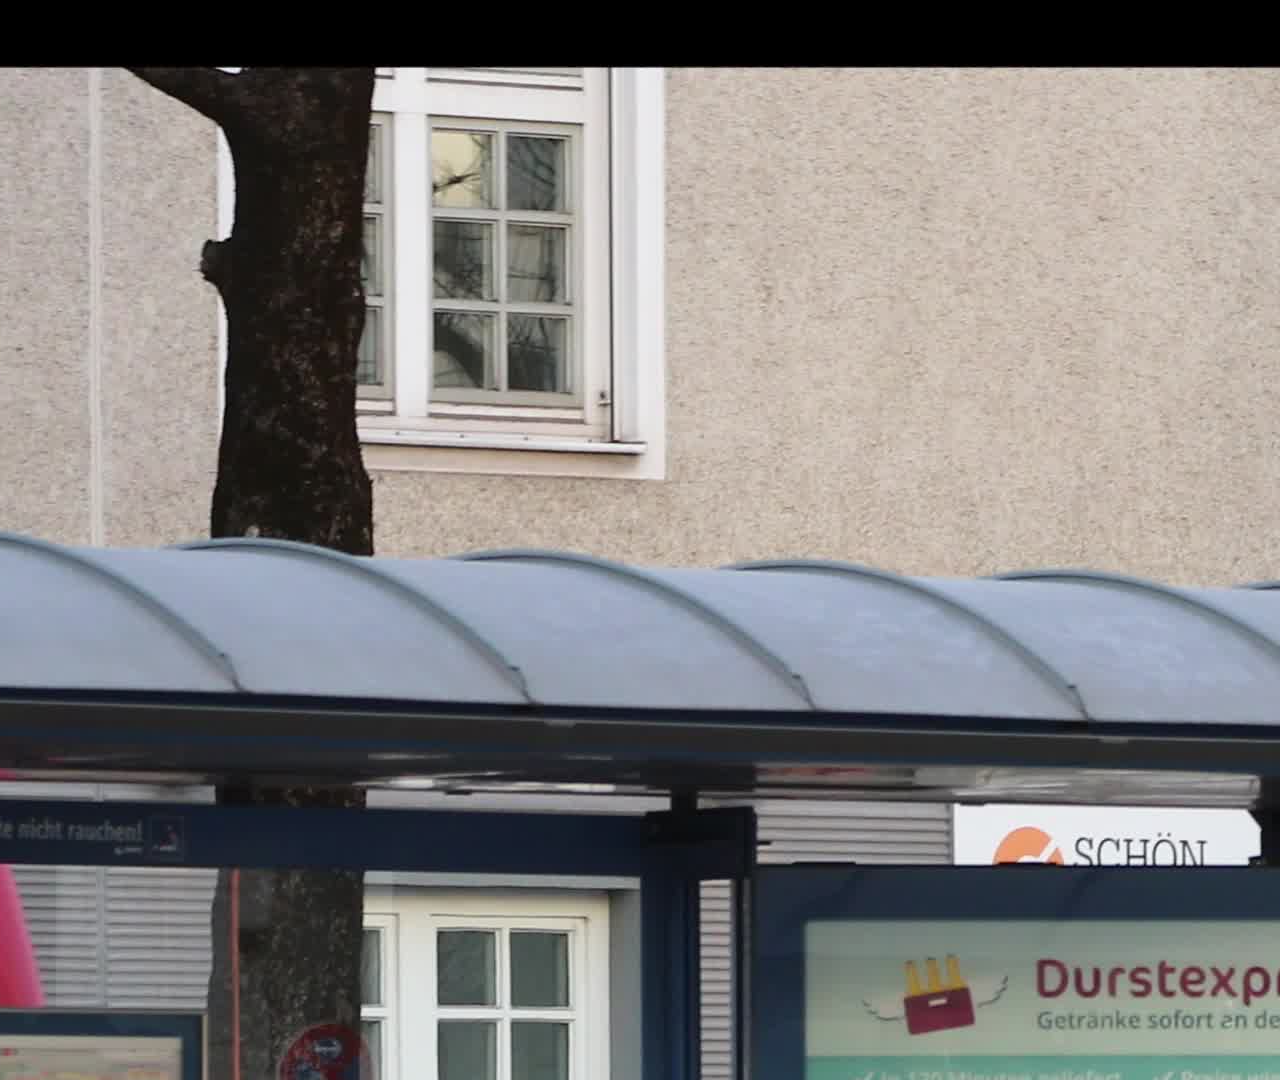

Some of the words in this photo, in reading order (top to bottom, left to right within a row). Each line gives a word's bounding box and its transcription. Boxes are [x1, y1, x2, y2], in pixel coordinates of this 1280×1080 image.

[20, 817, 63, 840] nicht
[1073, 832, 1208, 866] SCHÖN
[1147, 1009, 1213, 1030] sofort
[1220, 1012, 1248, 1030] an
